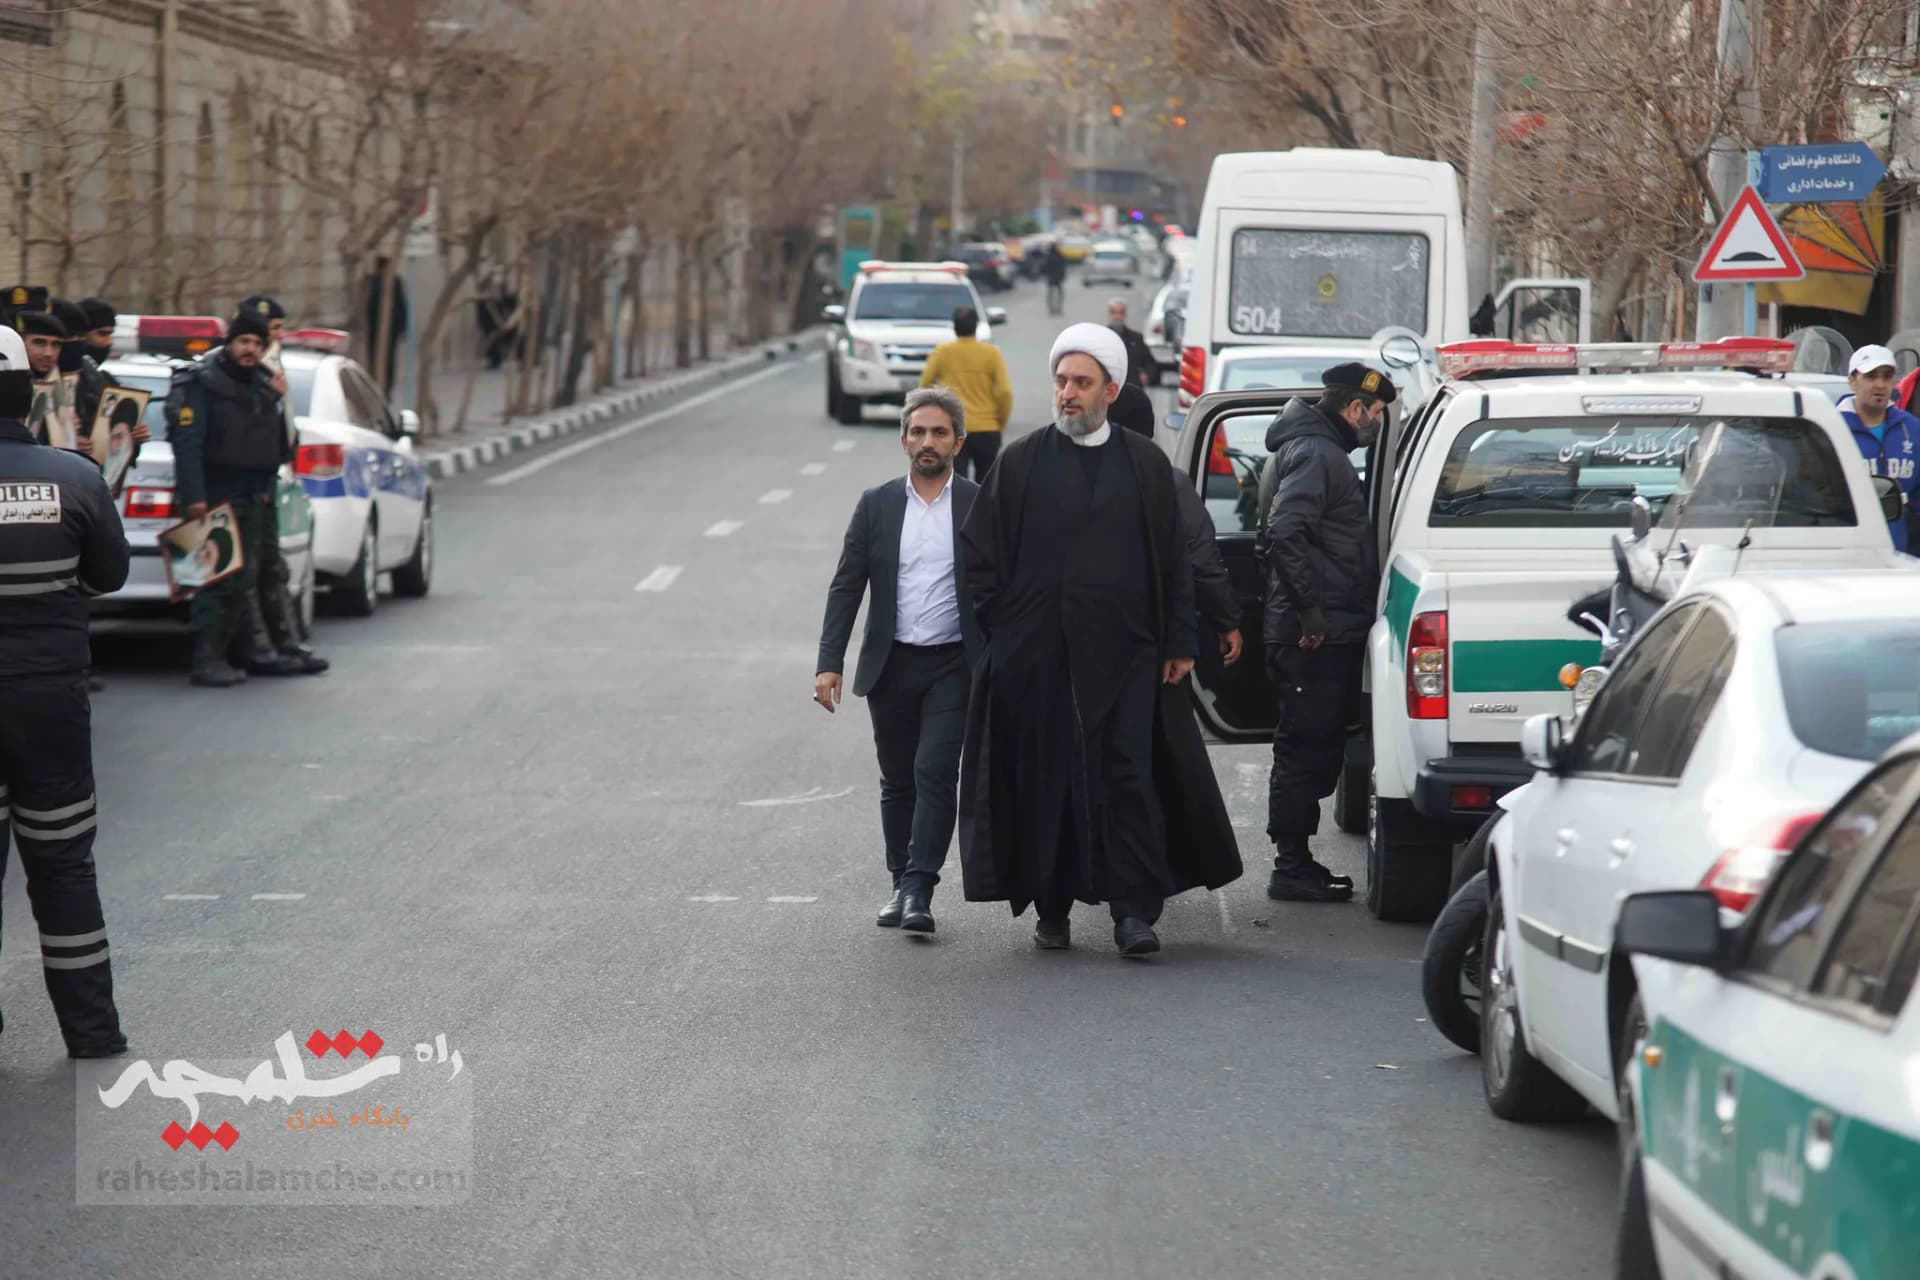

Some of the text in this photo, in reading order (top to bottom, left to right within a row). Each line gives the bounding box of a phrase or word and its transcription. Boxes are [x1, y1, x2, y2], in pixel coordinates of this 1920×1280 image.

[1807, 154, 1827, 169] علوم
[1828, 153, 1862, 166] دانشگاه
[1787, 176, 1855, 193] و خدمات اداری
[1234, 306, 1282, 333] 504
[1469, 704, 1519, 714] ISUZU
